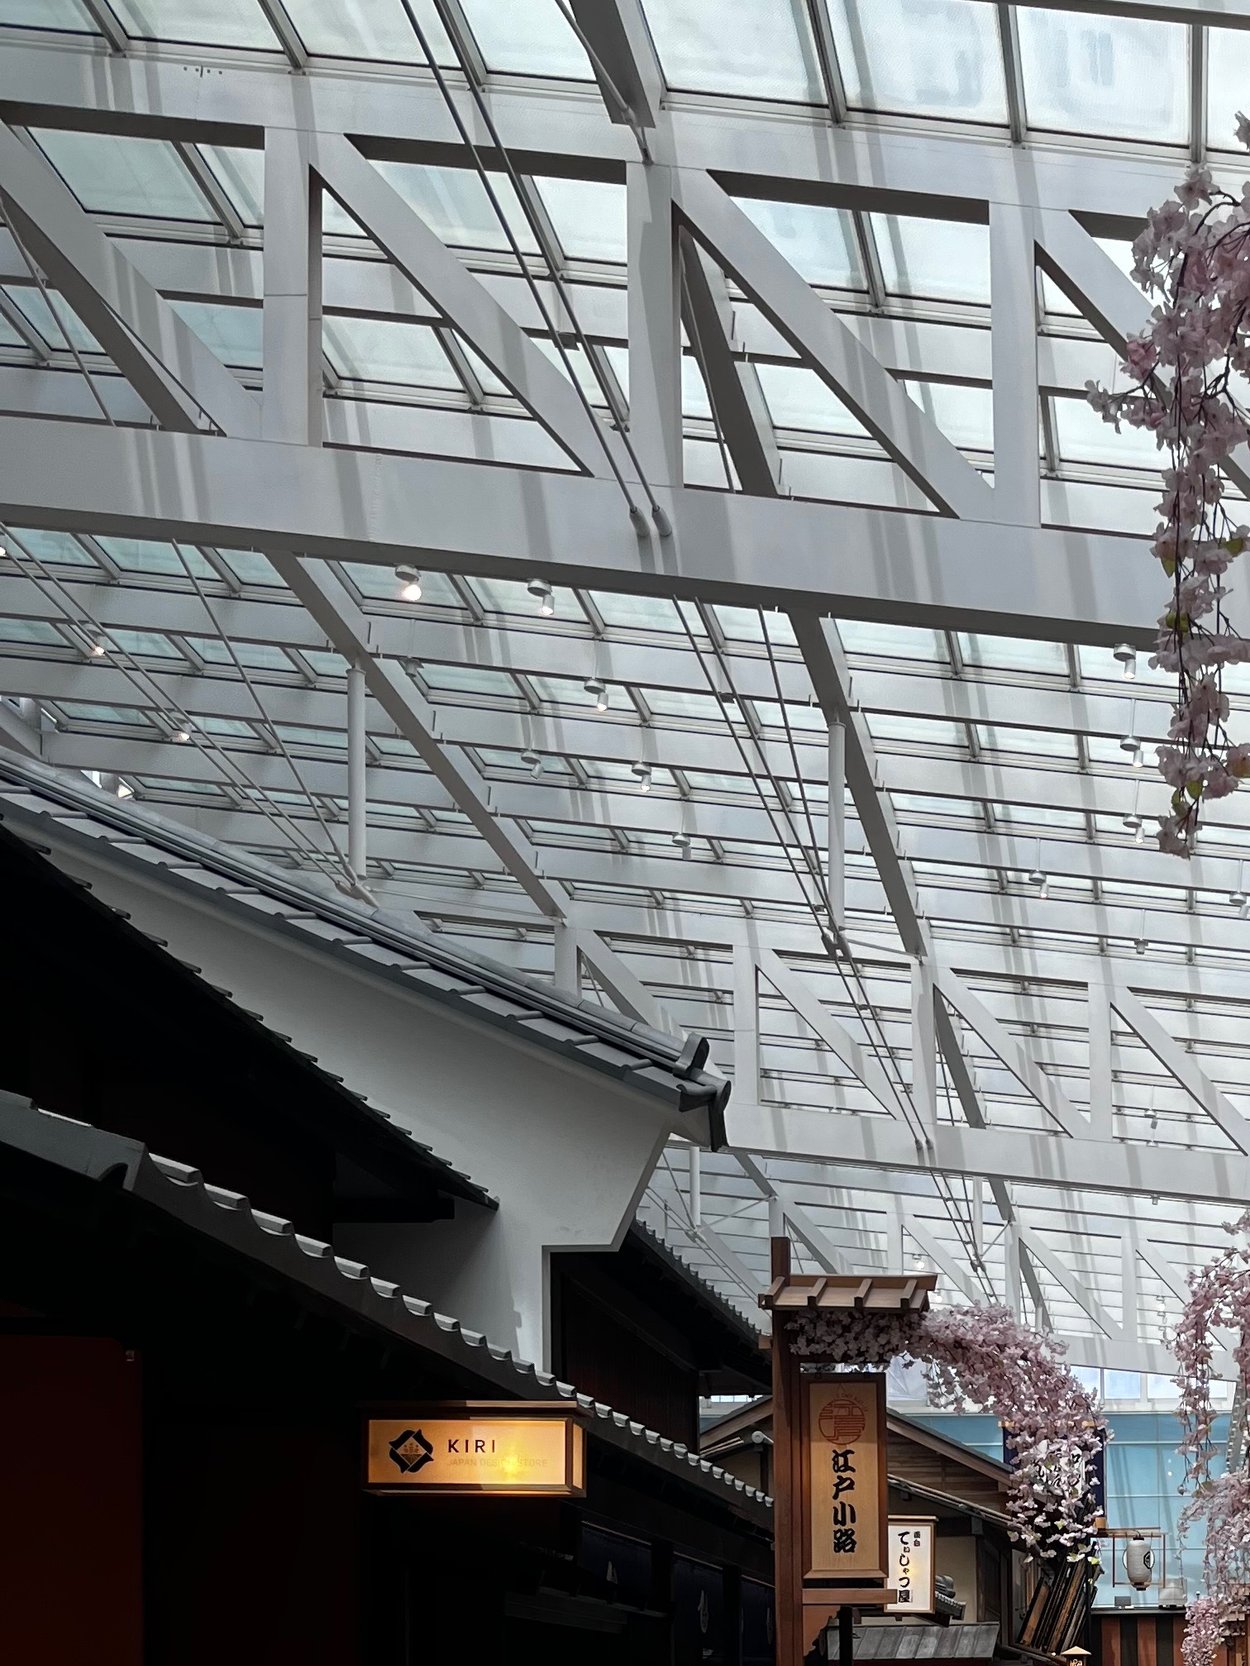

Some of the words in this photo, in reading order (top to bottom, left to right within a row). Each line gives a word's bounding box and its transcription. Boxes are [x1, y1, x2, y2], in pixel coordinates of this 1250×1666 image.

[447, 1439, 496, 1454] KIRI
[831, 1449, 857, 1553] 江戸小路
